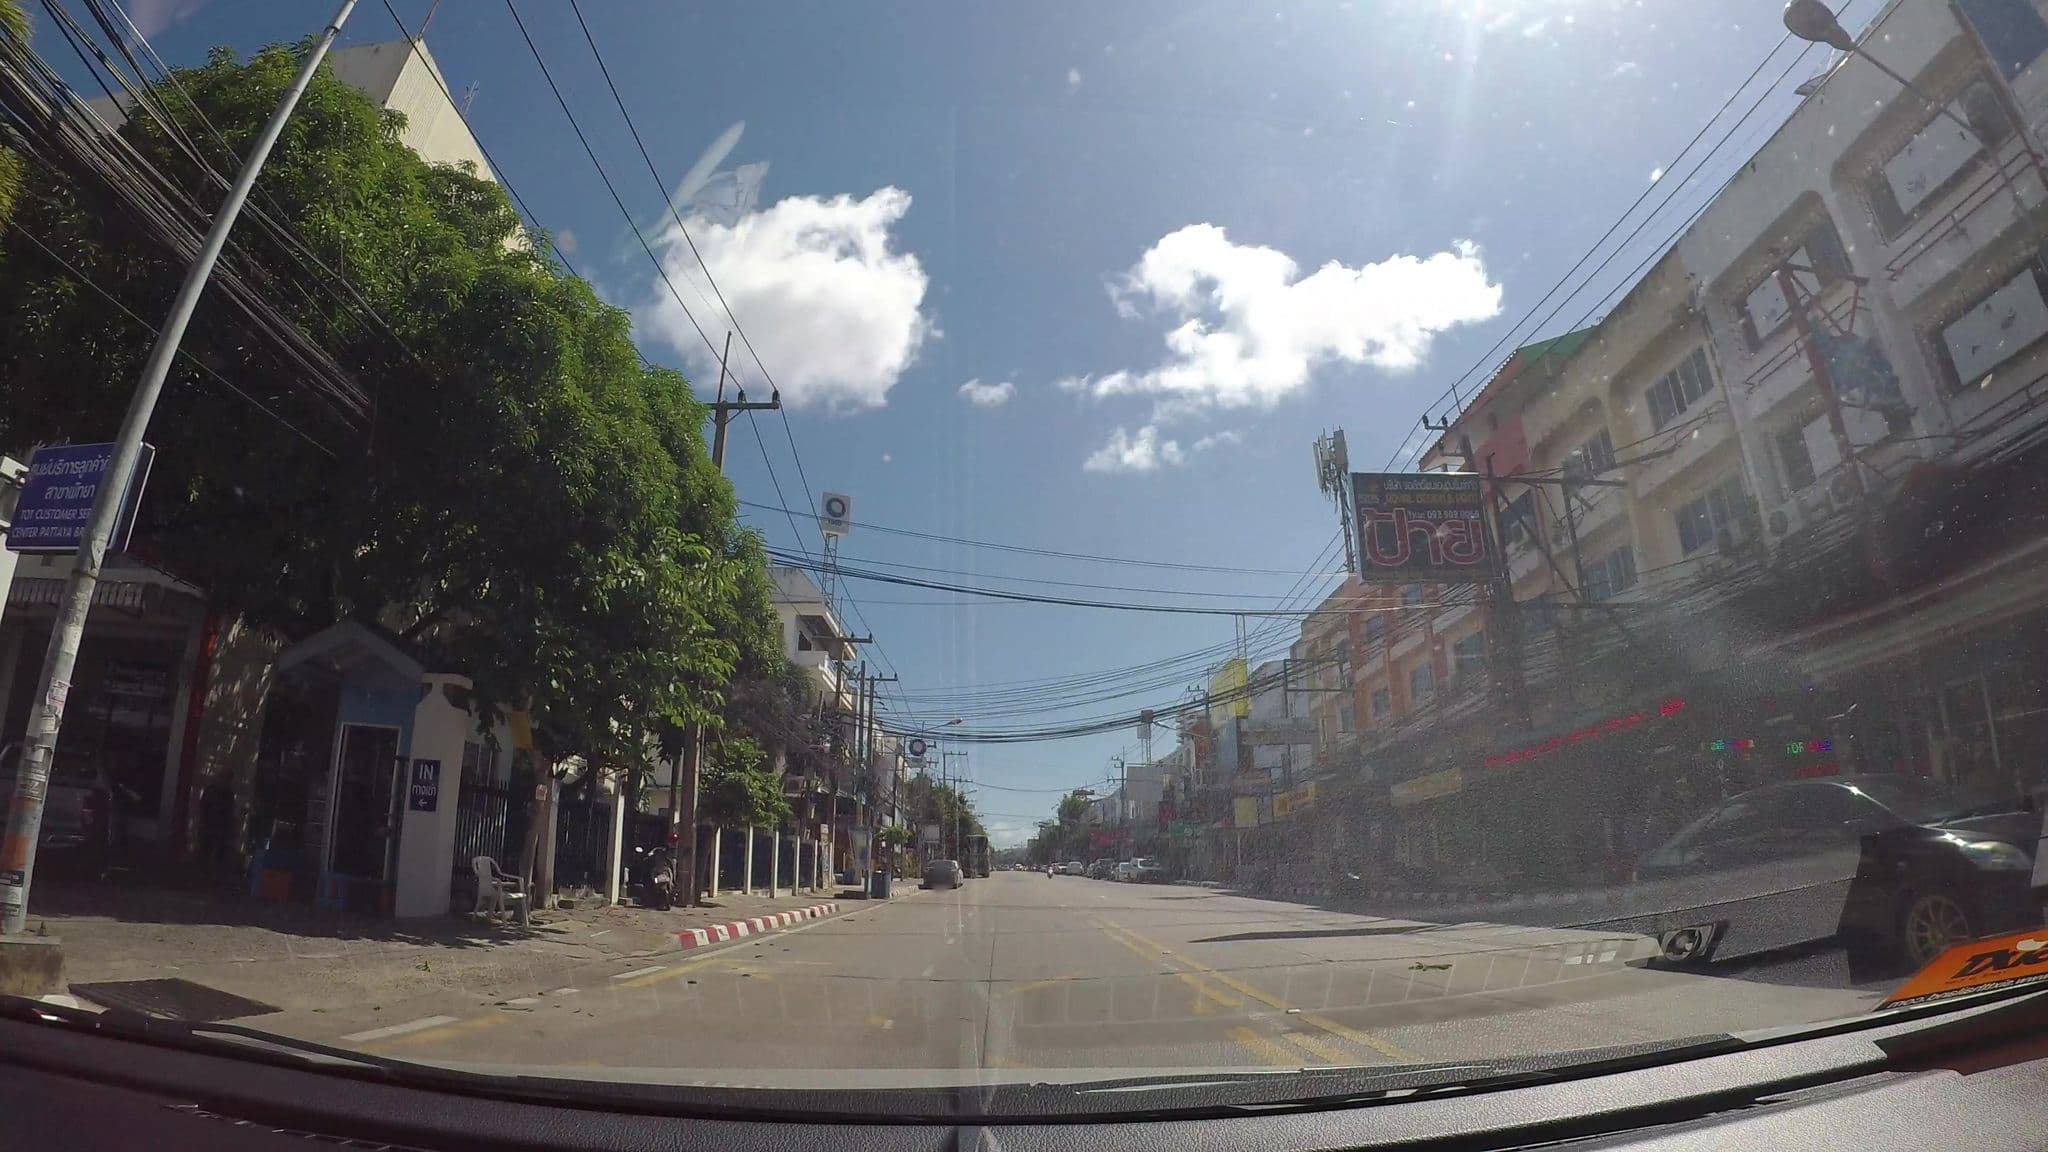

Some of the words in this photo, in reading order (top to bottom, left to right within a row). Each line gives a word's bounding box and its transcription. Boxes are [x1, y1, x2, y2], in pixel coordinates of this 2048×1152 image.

[35, 508, 77, 520] CUSTOMER
[12, 527, 38, 538] CENTER
[39, 526, 72, 538] PATTAYA
[419, 763, 434, 780] IN
